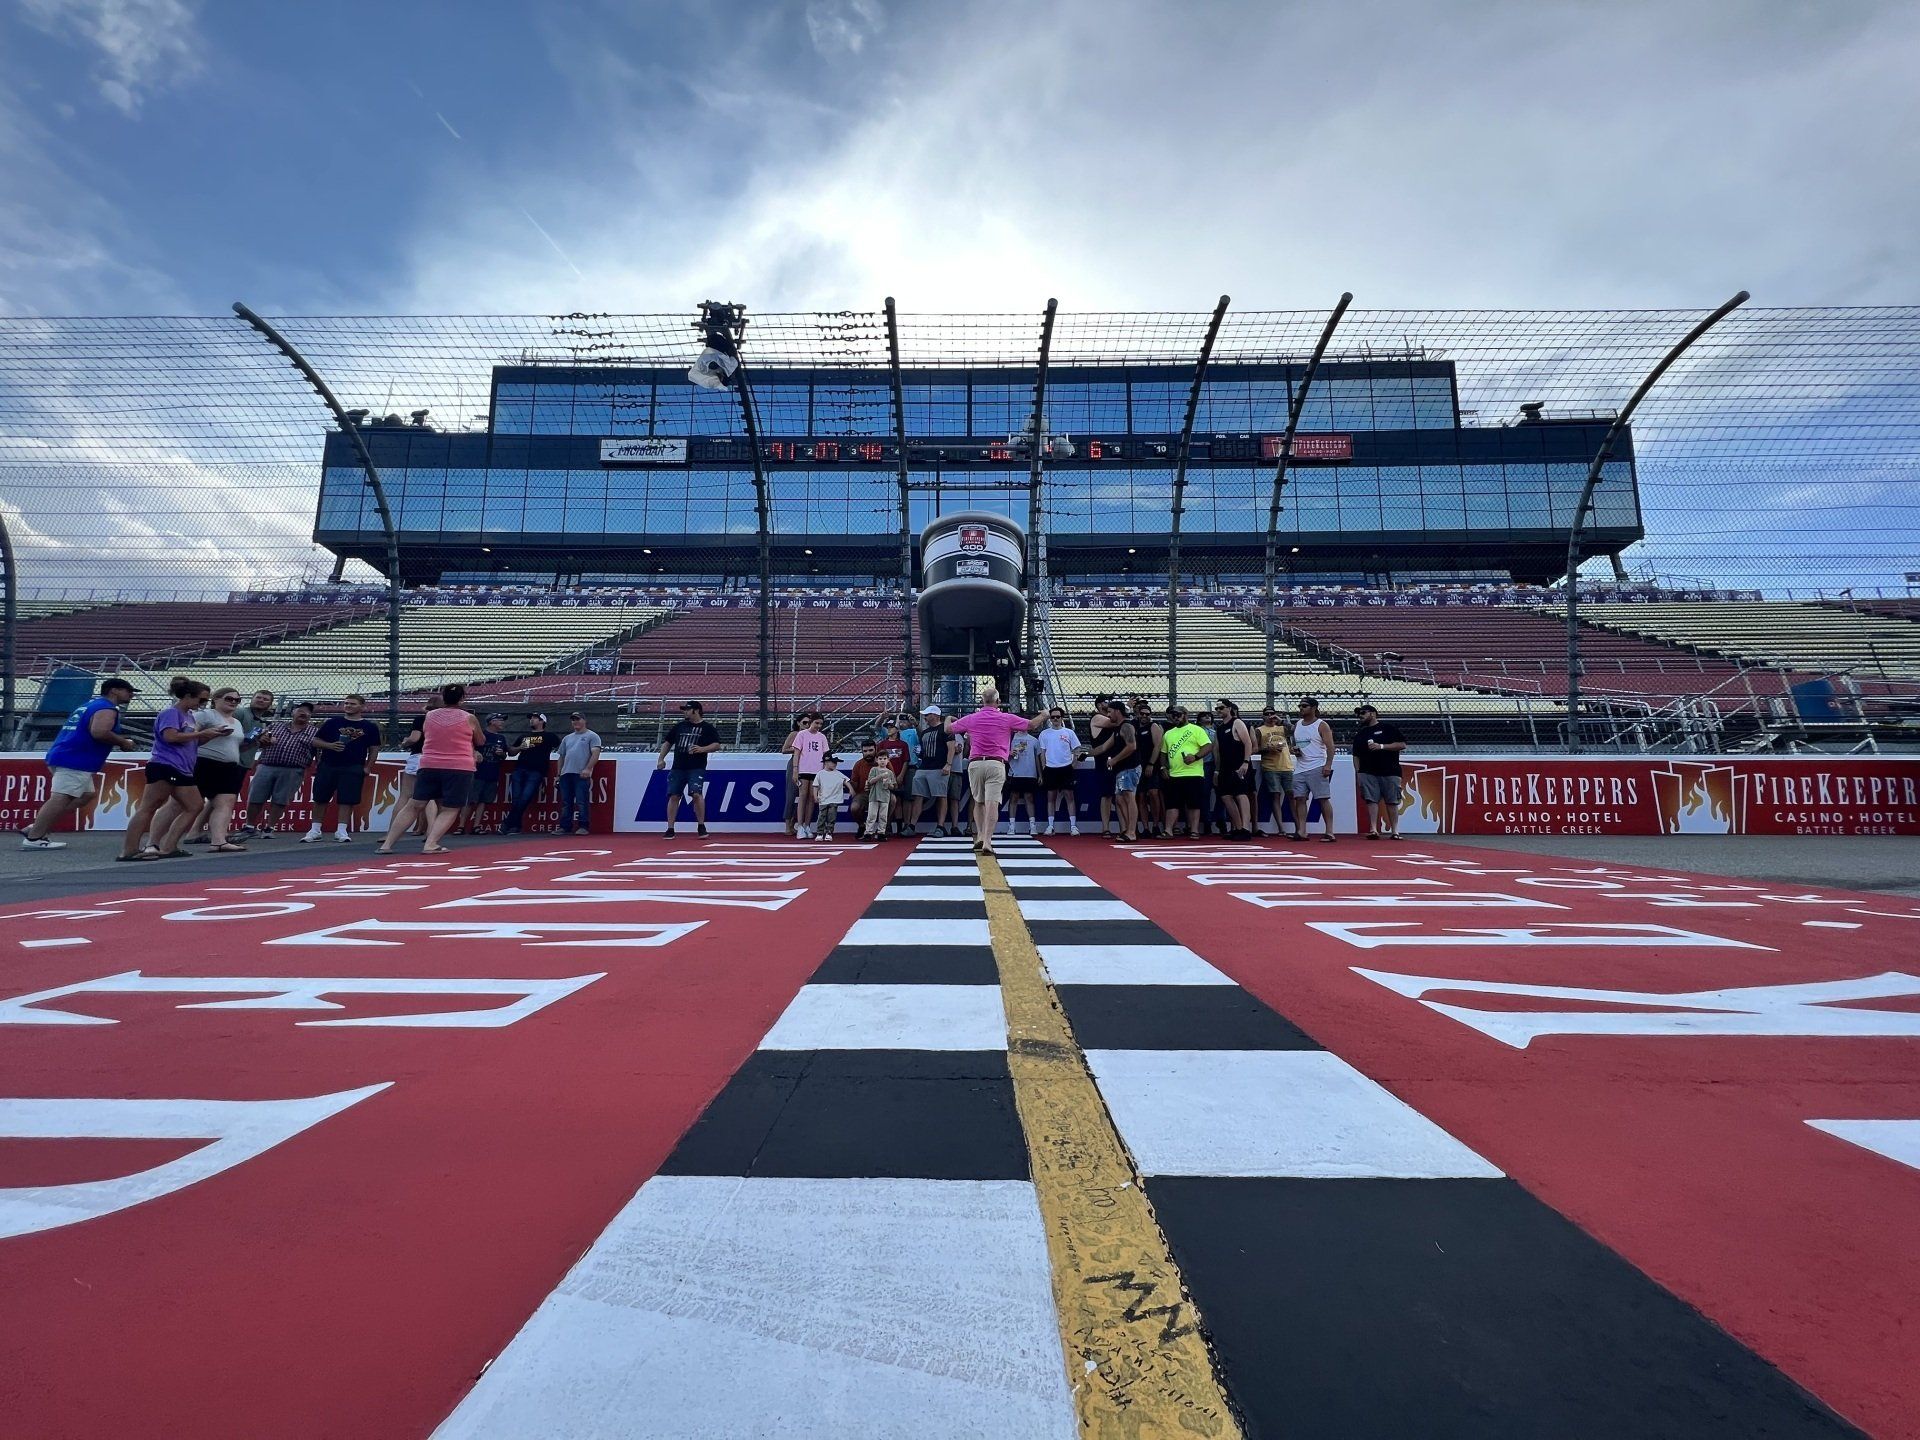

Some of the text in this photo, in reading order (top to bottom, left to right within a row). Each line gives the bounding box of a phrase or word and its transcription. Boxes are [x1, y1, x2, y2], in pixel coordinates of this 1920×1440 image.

[512, 598, 530, 607] ally
[562, 598, 580, 607] ally
[660, 598, 678, 608] ally
[710, 598, 728, 608] ally
[813, 598, 830, 608] ally
[862, 598, 880, 608] ally
[1064, 598, 1081, 608] ally
[1113, 598, 1131, 608] ally
[1214, 598, 1232, 608] ally
[1318, 597, 1336, 607] ally
[1368, 596, 1386, 606] ally
[1420, 596, 1438, 606] ally
[1471, 595, 1490, 606] ally
[1484, 812, 1622, 822] CASINO HOTEL
[1774, 812, 1916, 822] CASINO HOTEL
[1505, 826, 1602, 834] BATTLE CREEK
[1796, 826, 1896, 834] BATTLE CREEK
